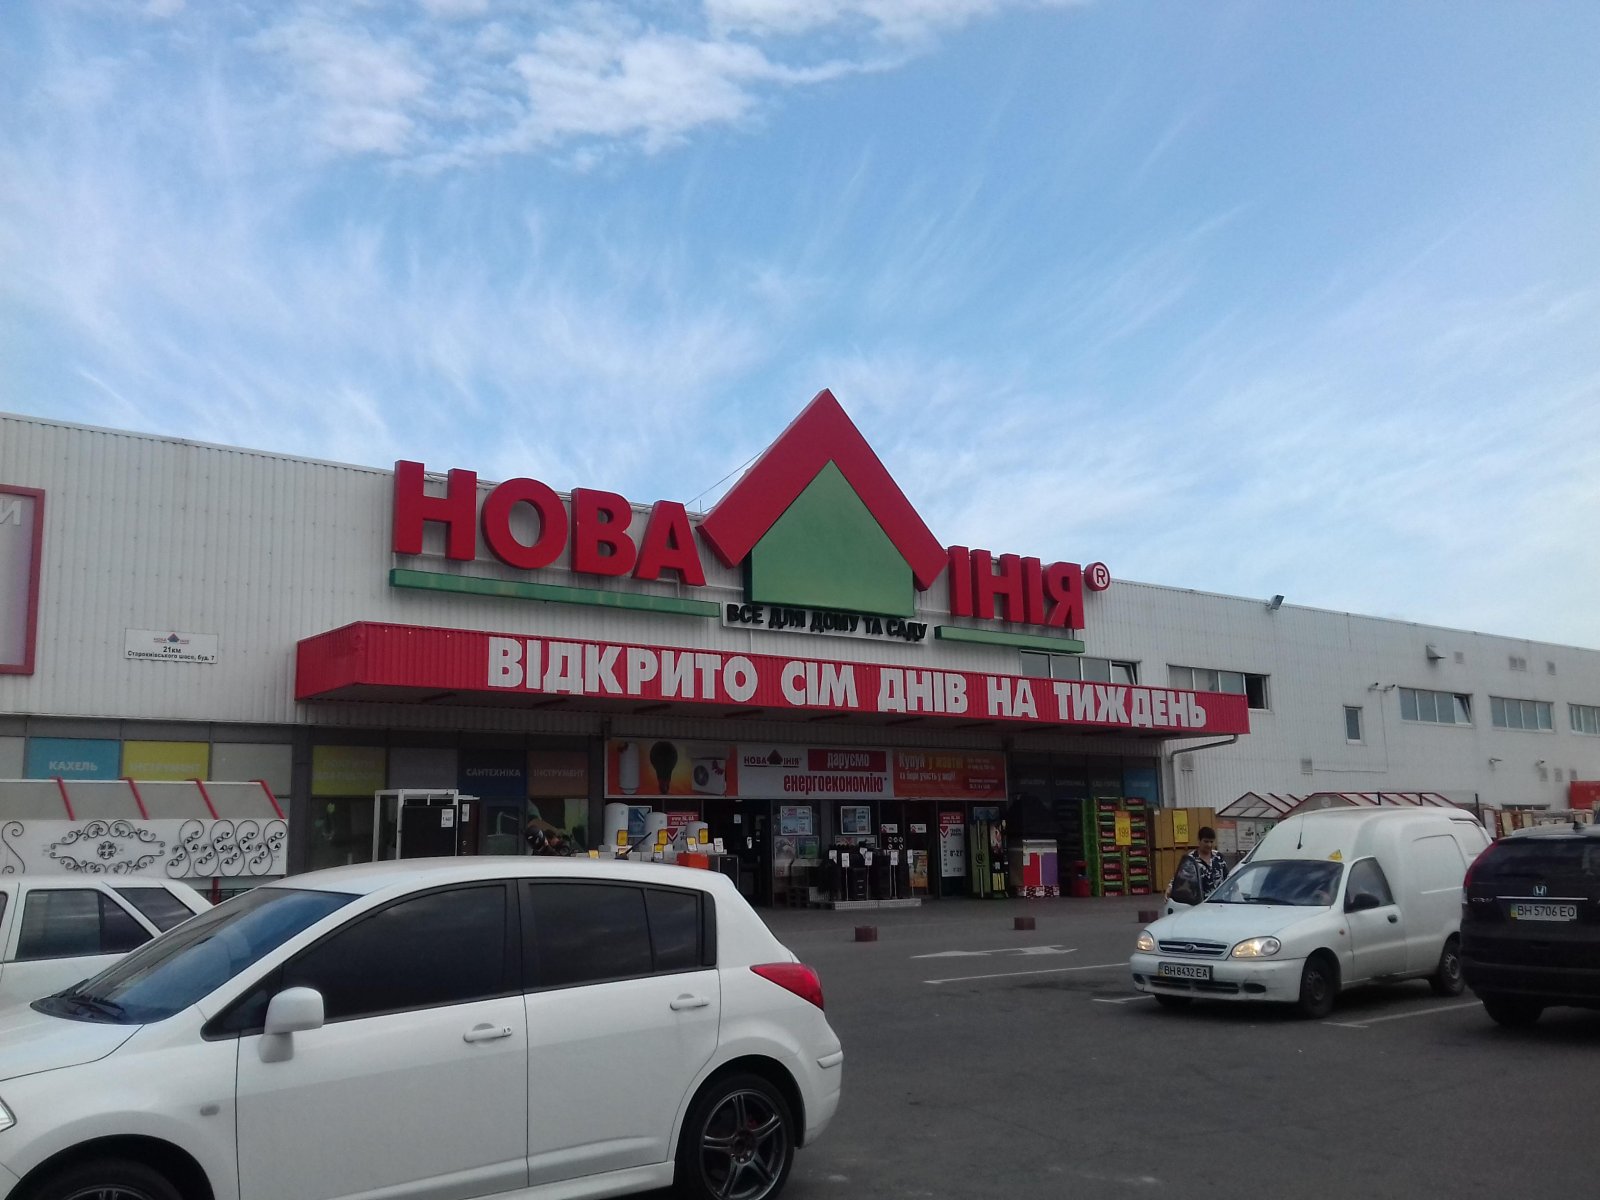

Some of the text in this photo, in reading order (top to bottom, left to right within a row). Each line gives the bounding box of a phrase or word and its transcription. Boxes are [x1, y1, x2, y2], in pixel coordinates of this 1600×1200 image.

[392, 460, 706, 587] НОВА
[947, 545, 1085, 629] ІНІЯ
[726, 603, 928, 641] ВСЕ ДЛЯ ДОМУ ТА САДУ
[487, 636, 1206, 728] ВІДКРИТО СІМ ДНІВ НА ТИЖДЕНЬ
[744, 755, 767, 765] НОВА
[827, 752, 869, 769] даруємо
[48, 761, 98, 772] КАХЕЛЬ
[466, 768, 521, 778] САНТЕХНІКА
[534, 768, 584, 778] ІНСТРУМЕНТ
[1534, 906, 1557, 917] 5706
[1176, 967, 1194, 977] 8432
